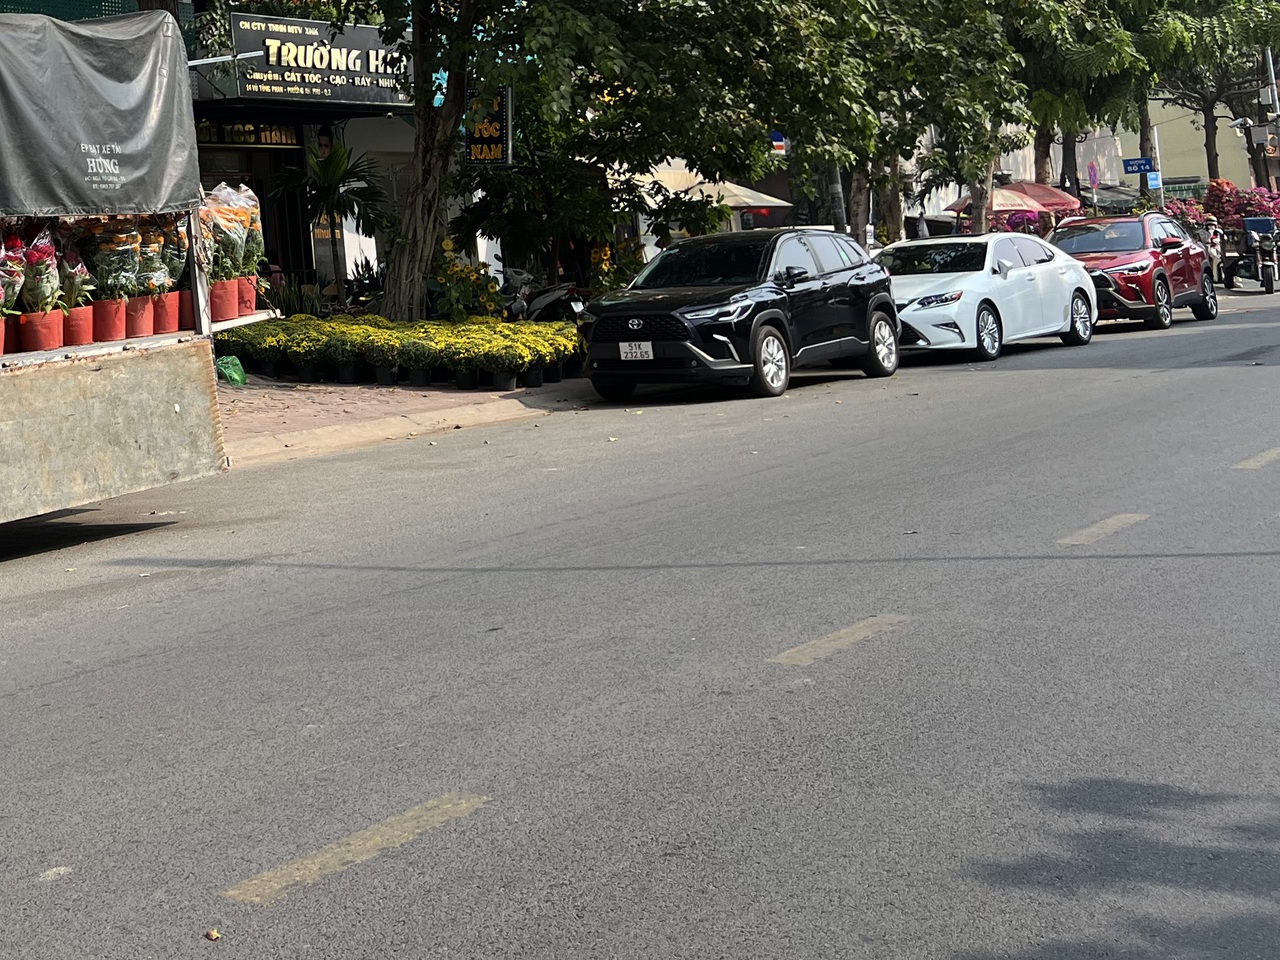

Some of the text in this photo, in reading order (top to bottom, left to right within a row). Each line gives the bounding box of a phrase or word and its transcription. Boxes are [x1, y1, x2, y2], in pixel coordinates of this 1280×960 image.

[251, 21, 266, 32] CTY
[304, 71, 322, 85] TÓC
[329, 77, 347, 88] CẠO
[102, 144, 111, 154] XE
[471, 143, 503, 159] NAM
[628, 342, 642, 351] 51K
[623, 350, 650, 359] 232.65
